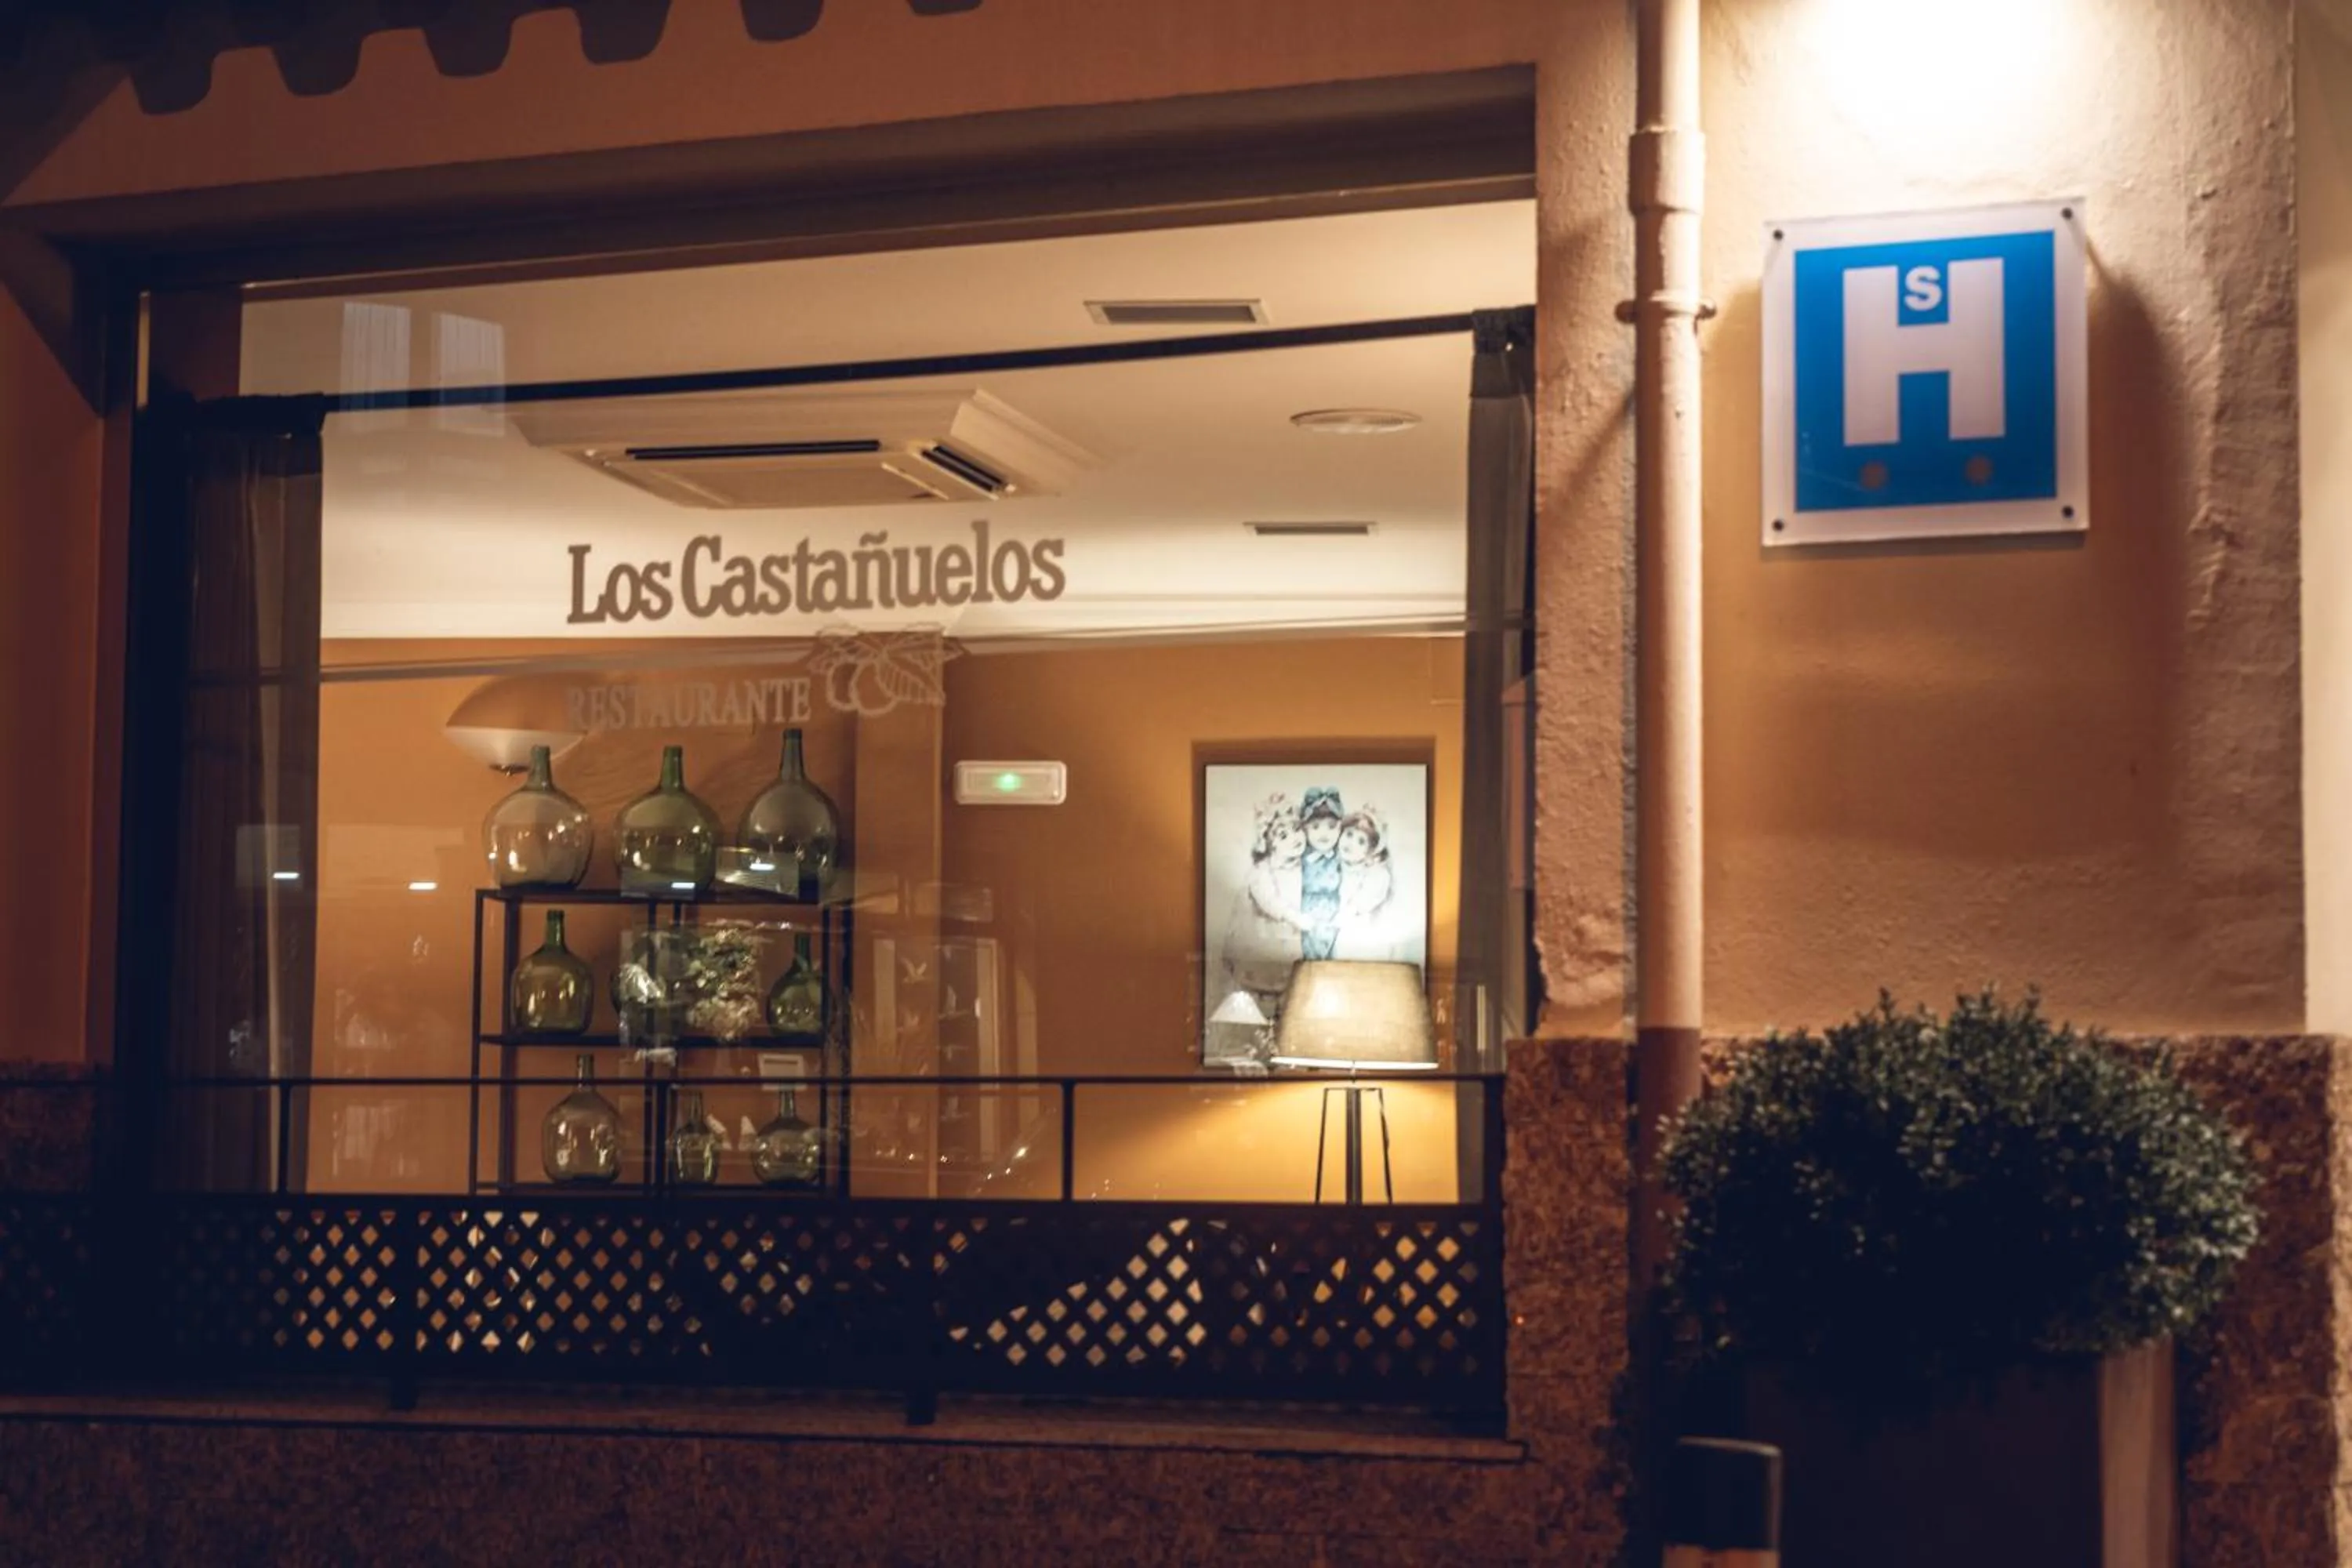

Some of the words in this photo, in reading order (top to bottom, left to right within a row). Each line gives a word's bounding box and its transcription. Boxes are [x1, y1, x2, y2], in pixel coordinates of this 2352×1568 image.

[1904, 265, 1942, 310] S
[1842, 257, 2005, 445] H
[567, 543, 673, 624] Los
[681, 521, 1065, 618] Castañuelos
[568, 677, 812, 732] RESTAURANTE
